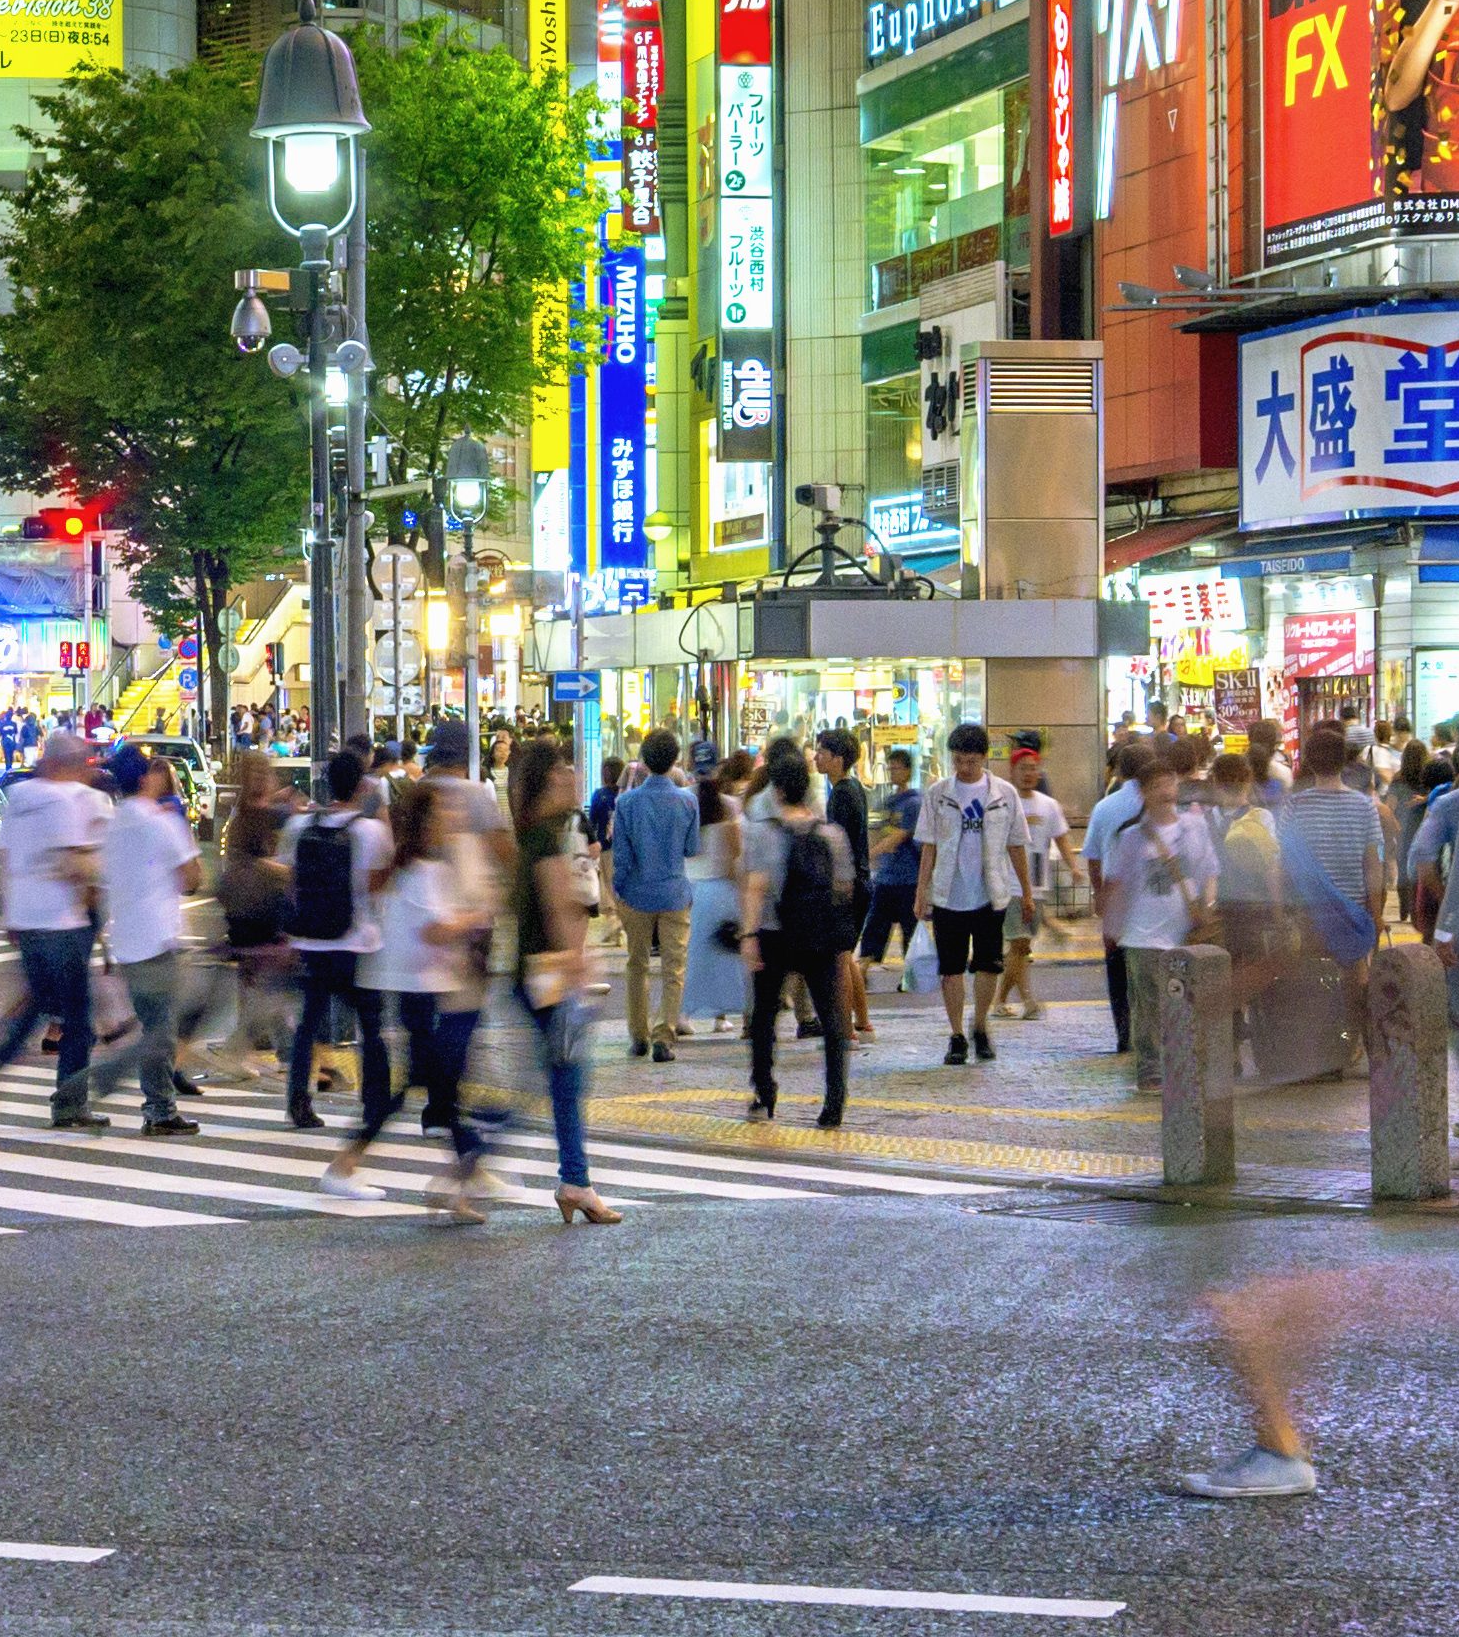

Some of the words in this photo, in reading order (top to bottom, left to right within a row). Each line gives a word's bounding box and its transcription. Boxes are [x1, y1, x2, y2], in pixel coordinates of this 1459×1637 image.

[634, 31, 653, 45] 6F
[1284, 4, 1347, 108] FX
[634, 133, 653, 146] 6F
[727, 101, 745, 167] パーラー
[749, 93, 764, 157] フルーツ
[729, 175, 743, 187] 2F
[728, 234, 746, 298] フルーツ
[750, 224, 764, 292] 渋谷西村
[614, 265, 637, 365] MIZUHO
[731, 307, 743, 319] 1F
[611, 437, 634, 542] みずほ銀行
[1260, 557, 1305, 575] TAISEIDO
[1215, 670, 1258, 690] SK-II
